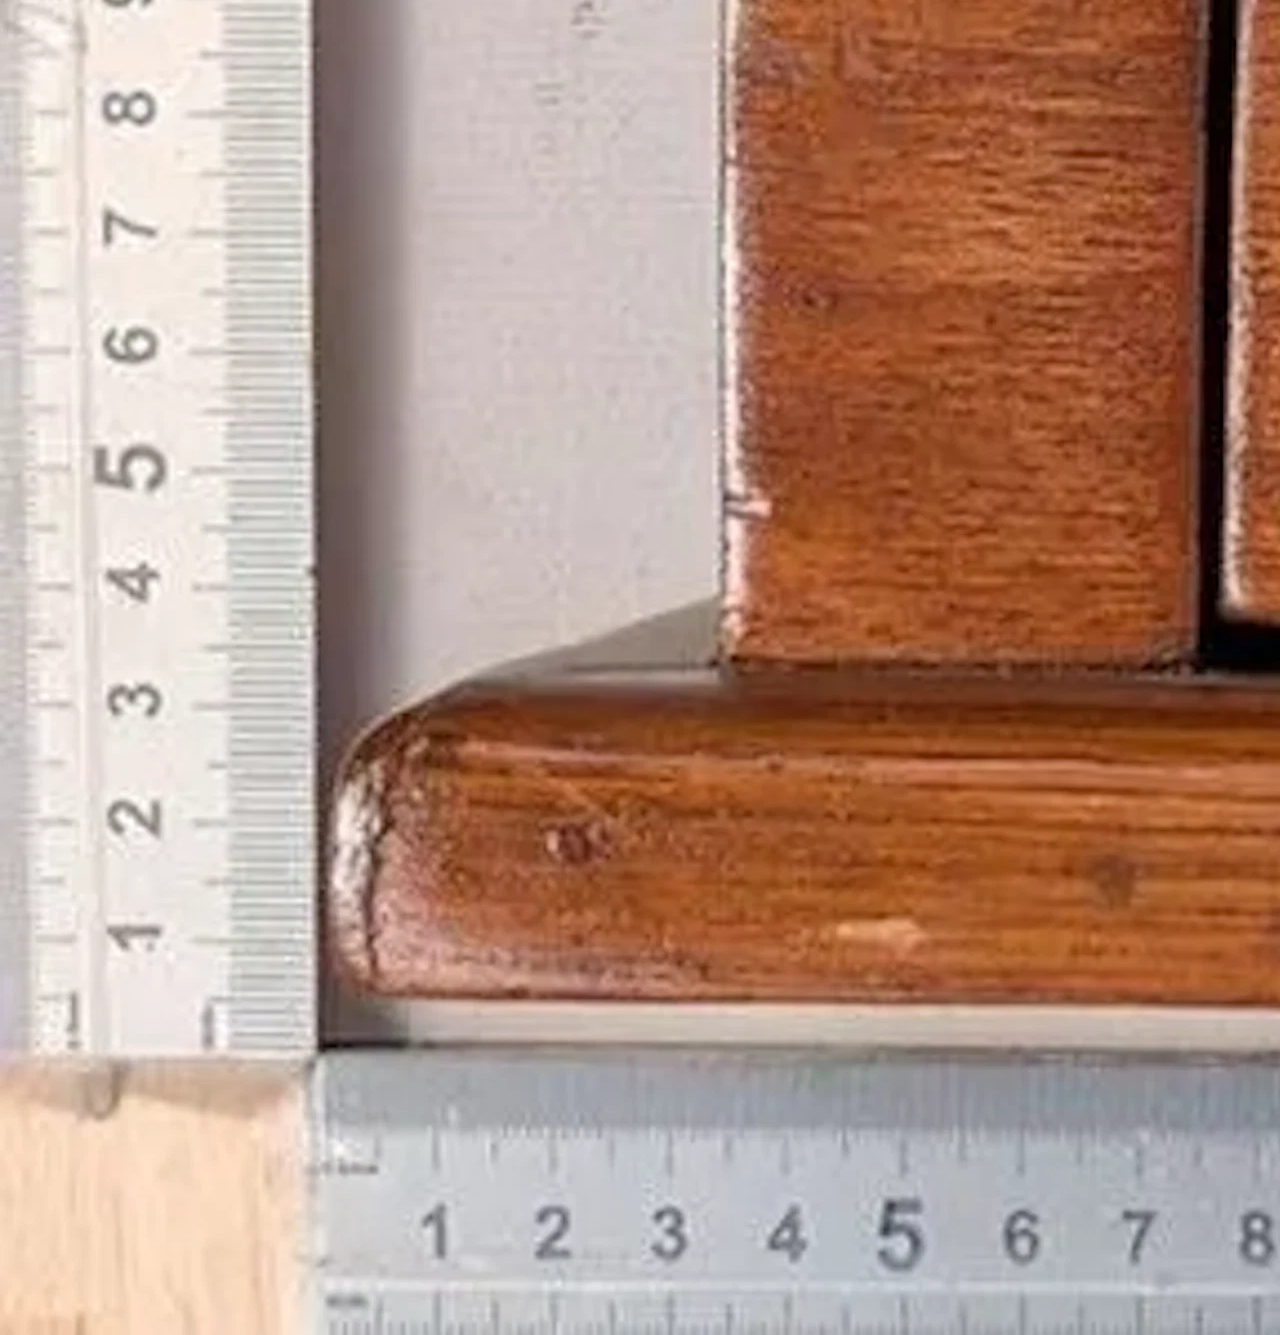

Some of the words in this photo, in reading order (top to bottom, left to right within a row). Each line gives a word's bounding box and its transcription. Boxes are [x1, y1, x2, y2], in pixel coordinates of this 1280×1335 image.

[102, 89, 156, 126] 8
[103, 210, 158, 245] 7
[103, 325, 159, 365] 6
[95, 444, 166, 491] 5
[105, 561, 160, 601] 4
[108, 681, 162, 719] 3
[108, 797, 162, 838] 2
[107, 924, 162, 952] 1
[420, 1206, 450, 1259] 1
[534, 1205, 573, 1260] 2
[651, 1206, 689, 1261] 3
[767, 1206, 807, 1262] 4
[878, 1198, 925, 1270] 5
[1003, 1208, 1040, 1264] 6
[1122, 1210, 1156, 1263] 7
[1239, 1210, 1275, 1266] 8
